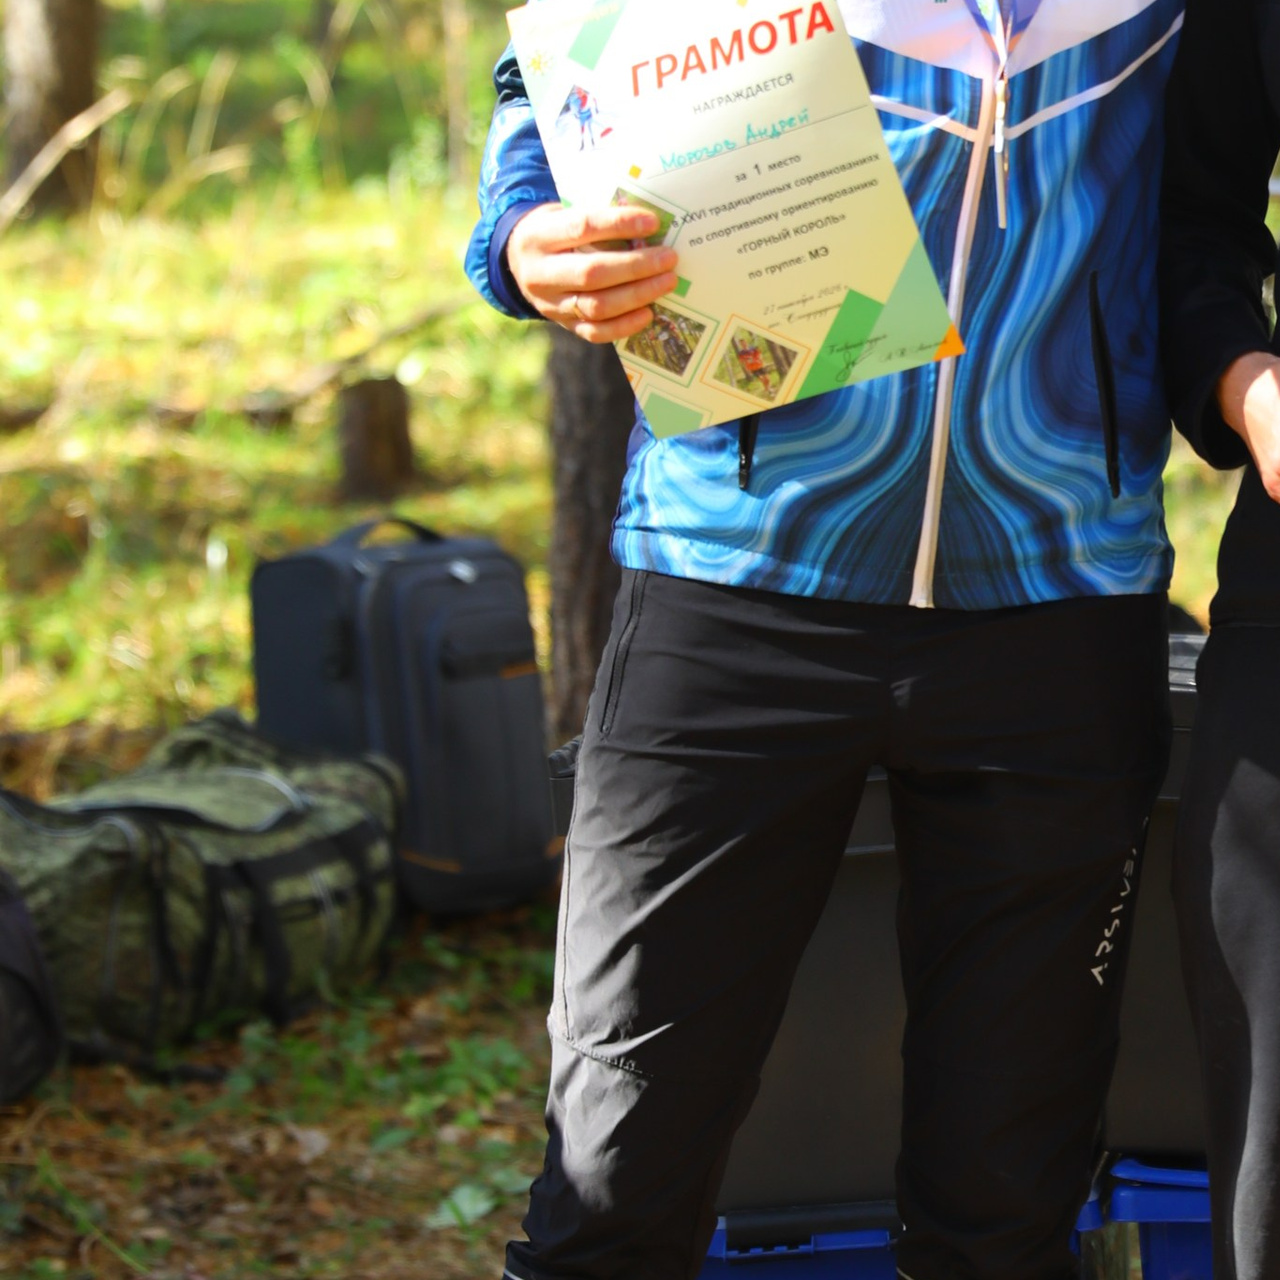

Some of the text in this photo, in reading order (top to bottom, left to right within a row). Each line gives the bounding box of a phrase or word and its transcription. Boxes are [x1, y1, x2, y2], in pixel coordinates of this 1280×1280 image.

[631, 1, 835, 97] ГРАМОТА
[693, 72, 795, 115] НАГРАЖДАЕТСЯ
[680, 209, 707, 226] XXVI
[709, 183, 793, 216] традиционных
[794, 153, 881, 189] соревнованиях
[735, 154, 802, 183] за 1 место
[688, 177, 879, 248] по спортивному ориентированию
[736, 213, 847, 256] «ГОРНЫЙ КОРОЛЬ»
[748, 269, 763, 280] по
[808, 246, 831, 261] МЭ
